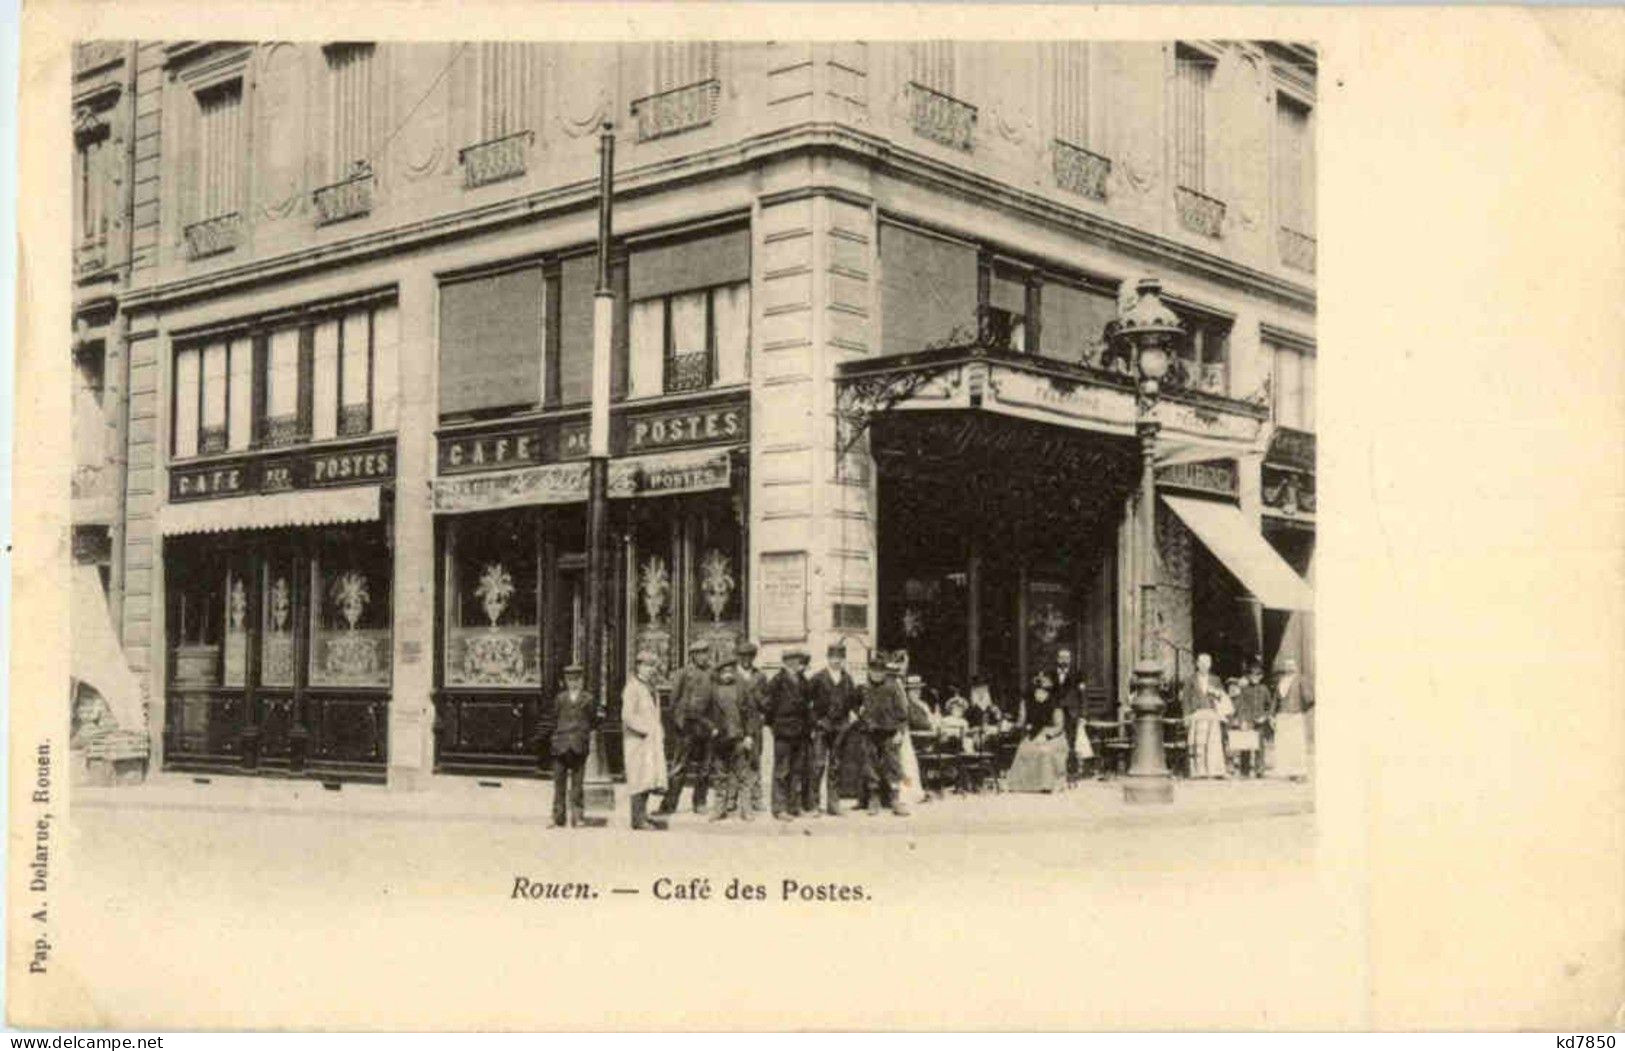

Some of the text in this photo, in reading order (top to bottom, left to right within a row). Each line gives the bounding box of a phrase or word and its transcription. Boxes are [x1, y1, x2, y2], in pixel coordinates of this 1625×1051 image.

[568, 432, 592, 449] DE
[635, 412, 739, 445] POSTES
[178, 469, 240, 494] CAFE
[314, 454, 389, 480] POSTES
